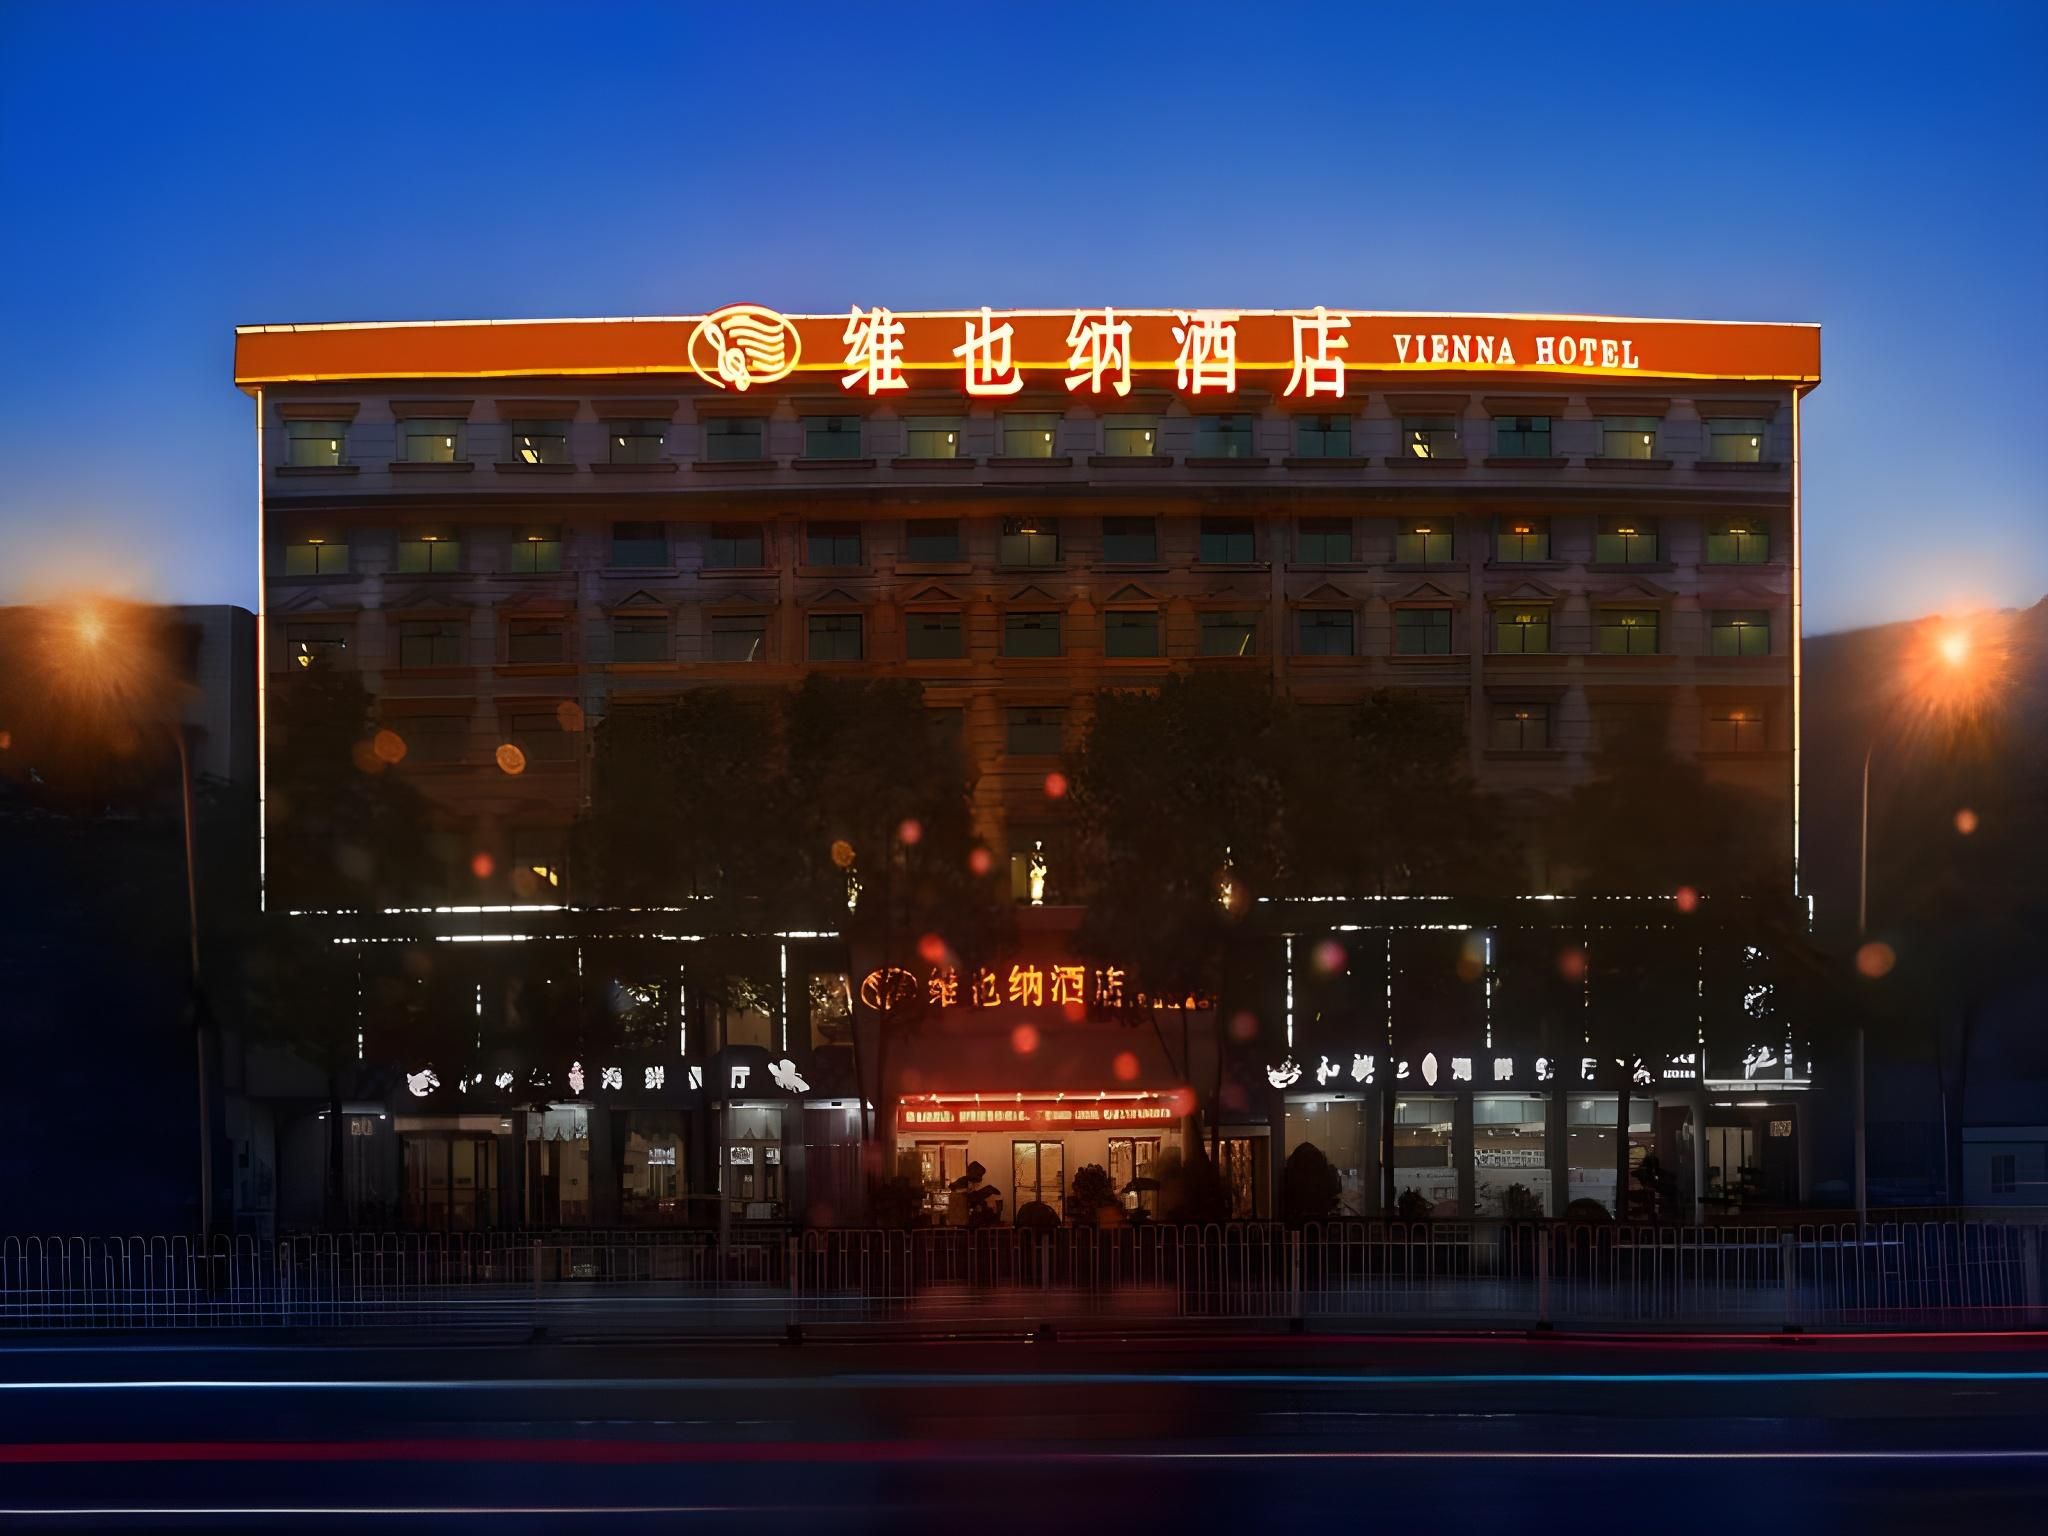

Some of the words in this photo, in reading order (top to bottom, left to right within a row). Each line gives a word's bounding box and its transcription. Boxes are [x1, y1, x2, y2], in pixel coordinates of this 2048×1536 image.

[842, 304, 1352, 398] 维也纳酒店
[1392, 334, 1516, 365] VIENNA
[1535, 336, 1640, 369] HOTEL
